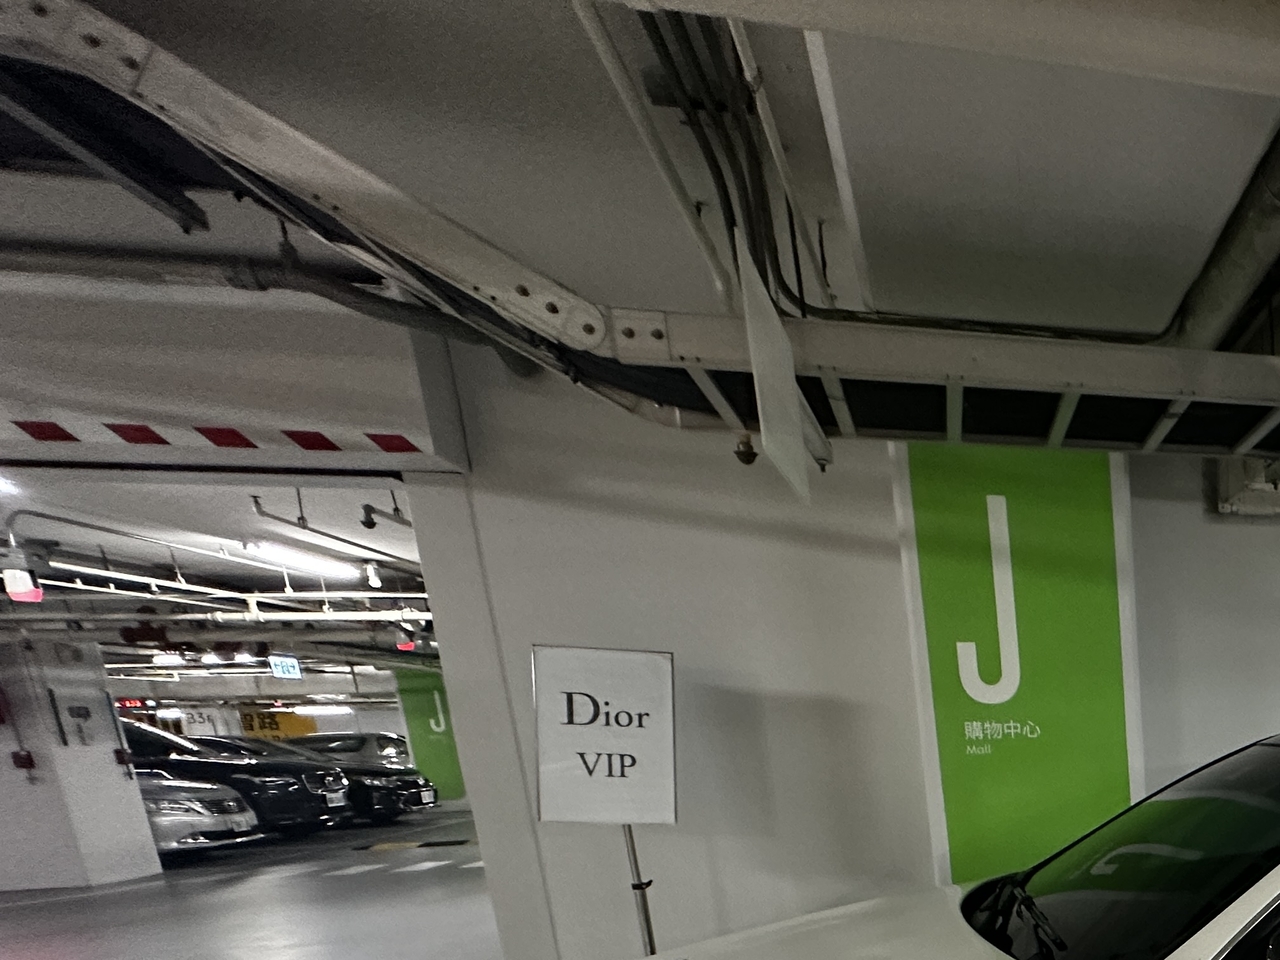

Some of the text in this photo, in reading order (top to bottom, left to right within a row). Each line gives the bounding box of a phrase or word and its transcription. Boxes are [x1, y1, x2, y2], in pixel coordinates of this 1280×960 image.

[956, 494, 1021, 704] J
[428, 689, 446, 732] J
[560, 691, 650, 728] Dior
[964, 719, 1041, 740] 購物中心
[576, 751, 637, 778] VIP
[965, 743, 992, 755] Mall
